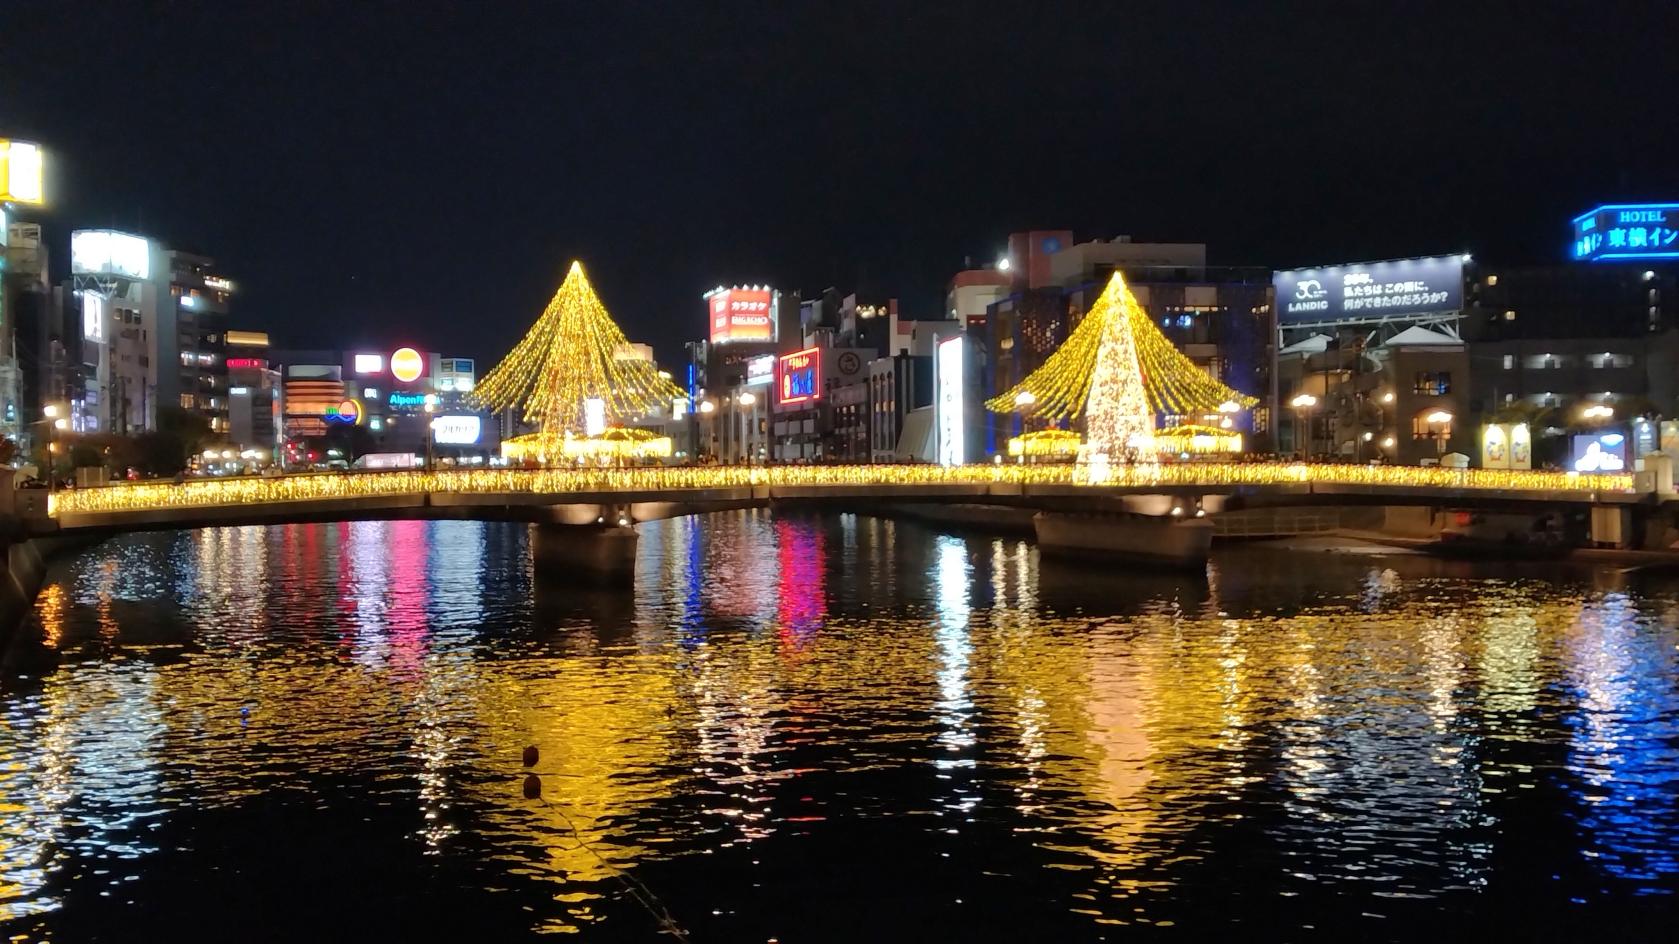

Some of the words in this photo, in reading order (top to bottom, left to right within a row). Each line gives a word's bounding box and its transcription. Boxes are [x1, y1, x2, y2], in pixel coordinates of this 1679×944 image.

[1620, 211, 1667, 222] HOTEL
[731, 301, 767, 311] カラオケ
[1288, 300, 1329, 312] LANDIC
